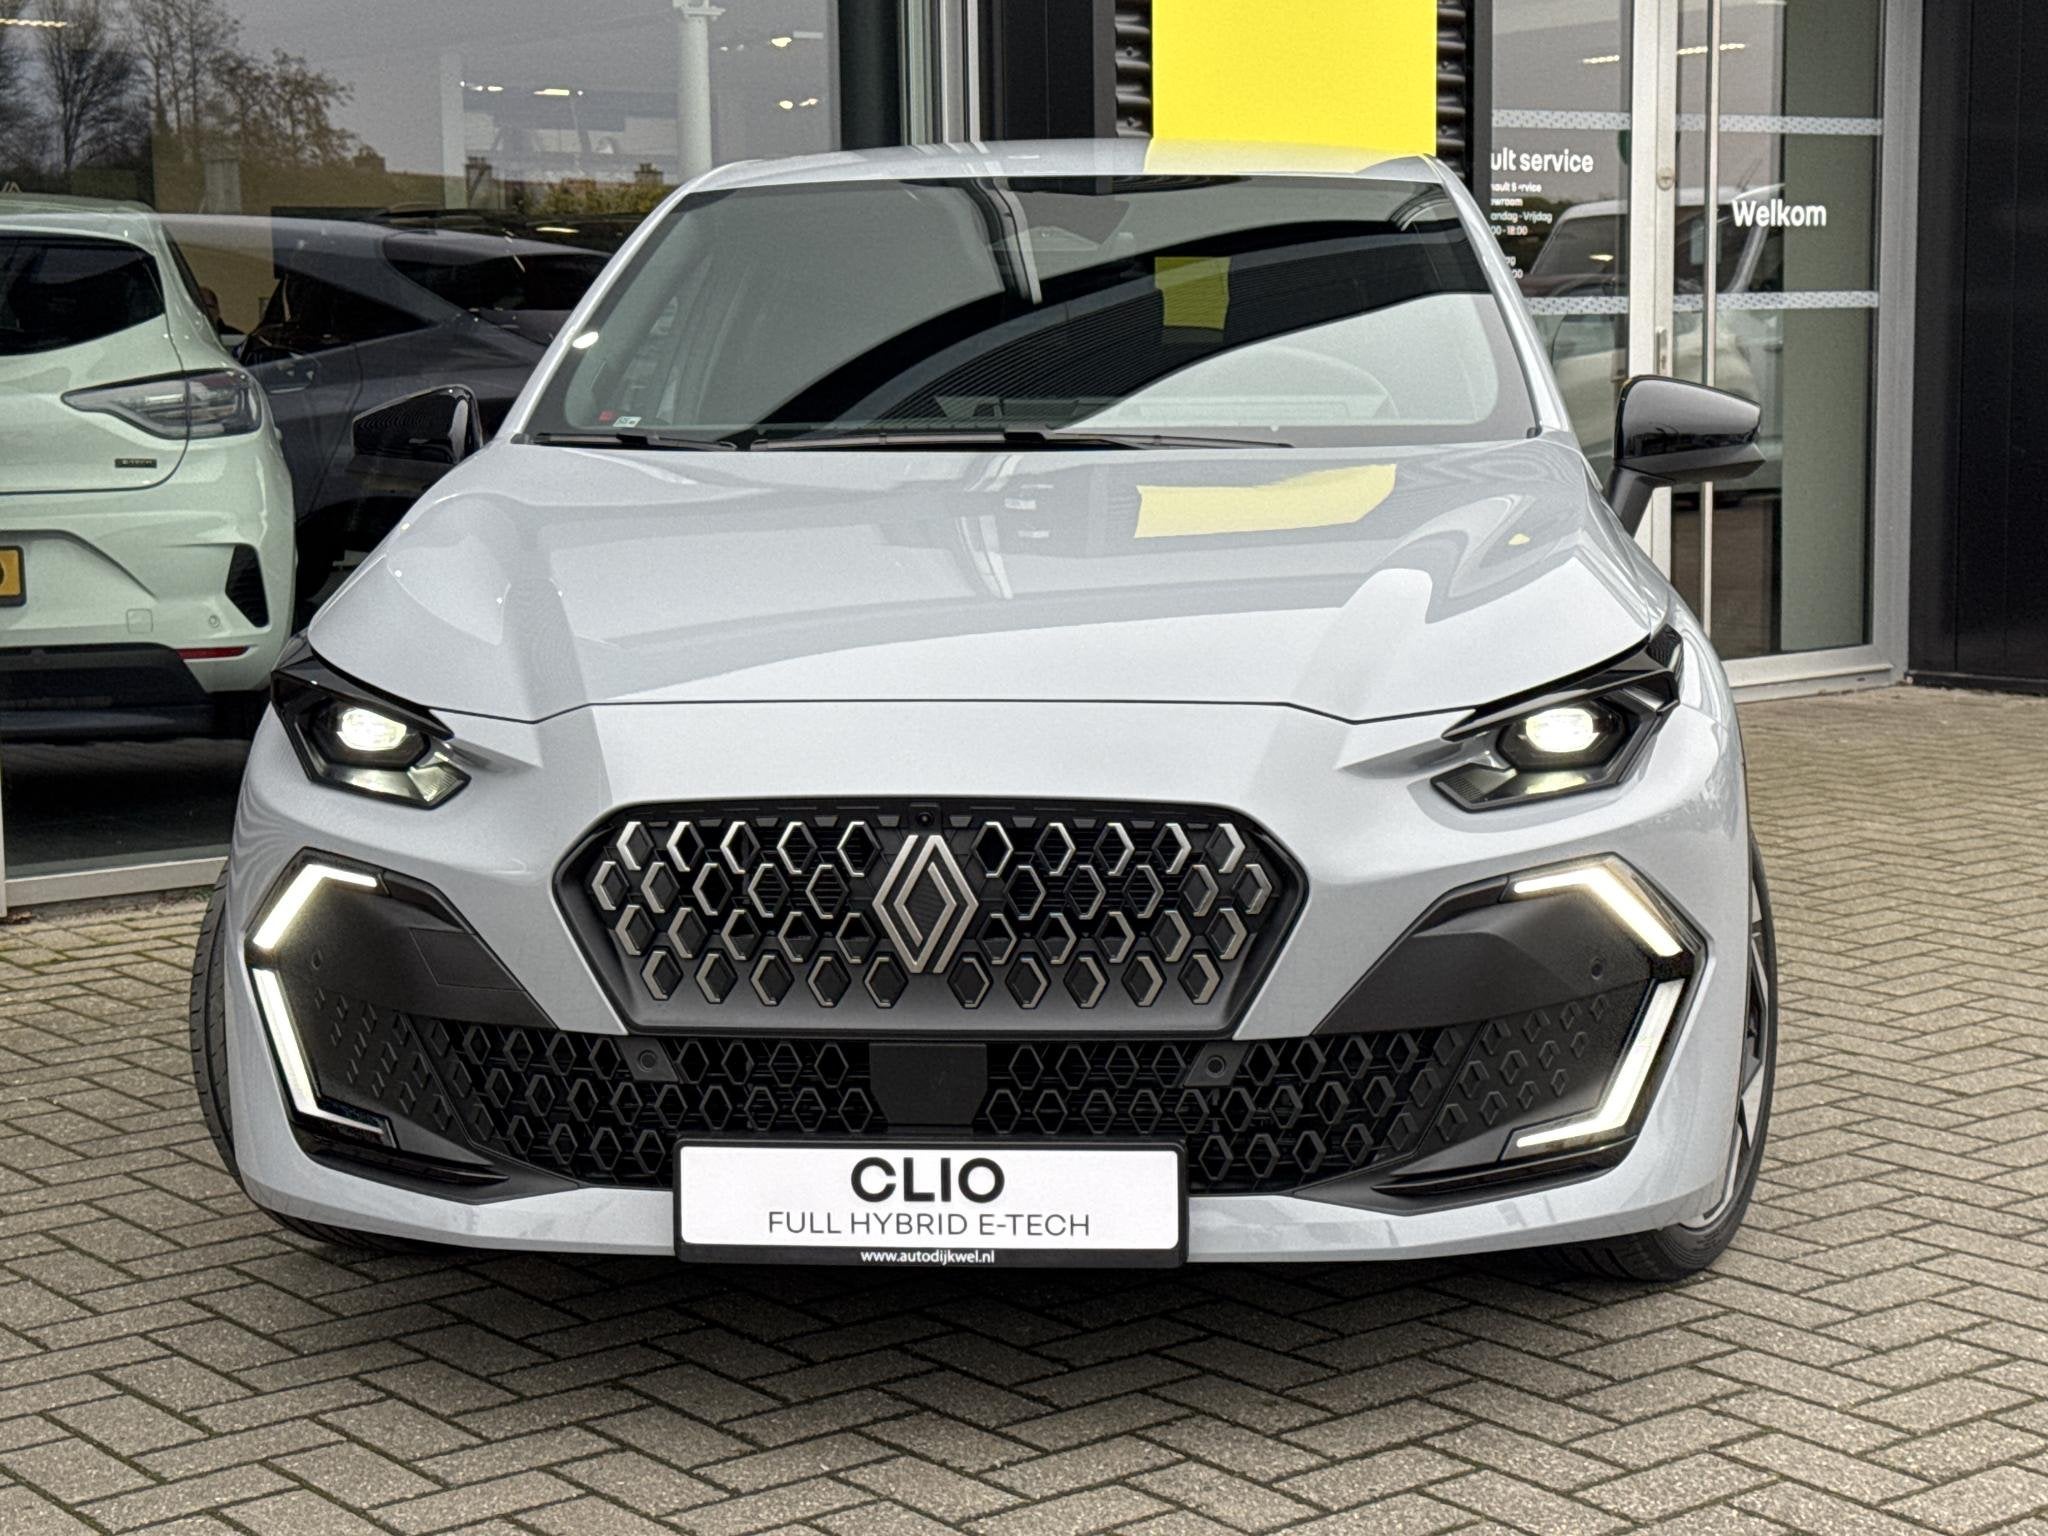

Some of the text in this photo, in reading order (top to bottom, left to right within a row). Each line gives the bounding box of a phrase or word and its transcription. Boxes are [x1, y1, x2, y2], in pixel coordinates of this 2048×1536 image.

[1519, 148, 1594, 173] service
[1522, 211, 1553, 224] Vrijdag
[1731, 198, 1827, 228] Welkom
[850, 1156, 1006, 1204] CLIO
[768, 1211, 1090, 1237] FULL HYBRID E-TECH
[859, 1249, 996, 1266] www.autodijkwel.nl
